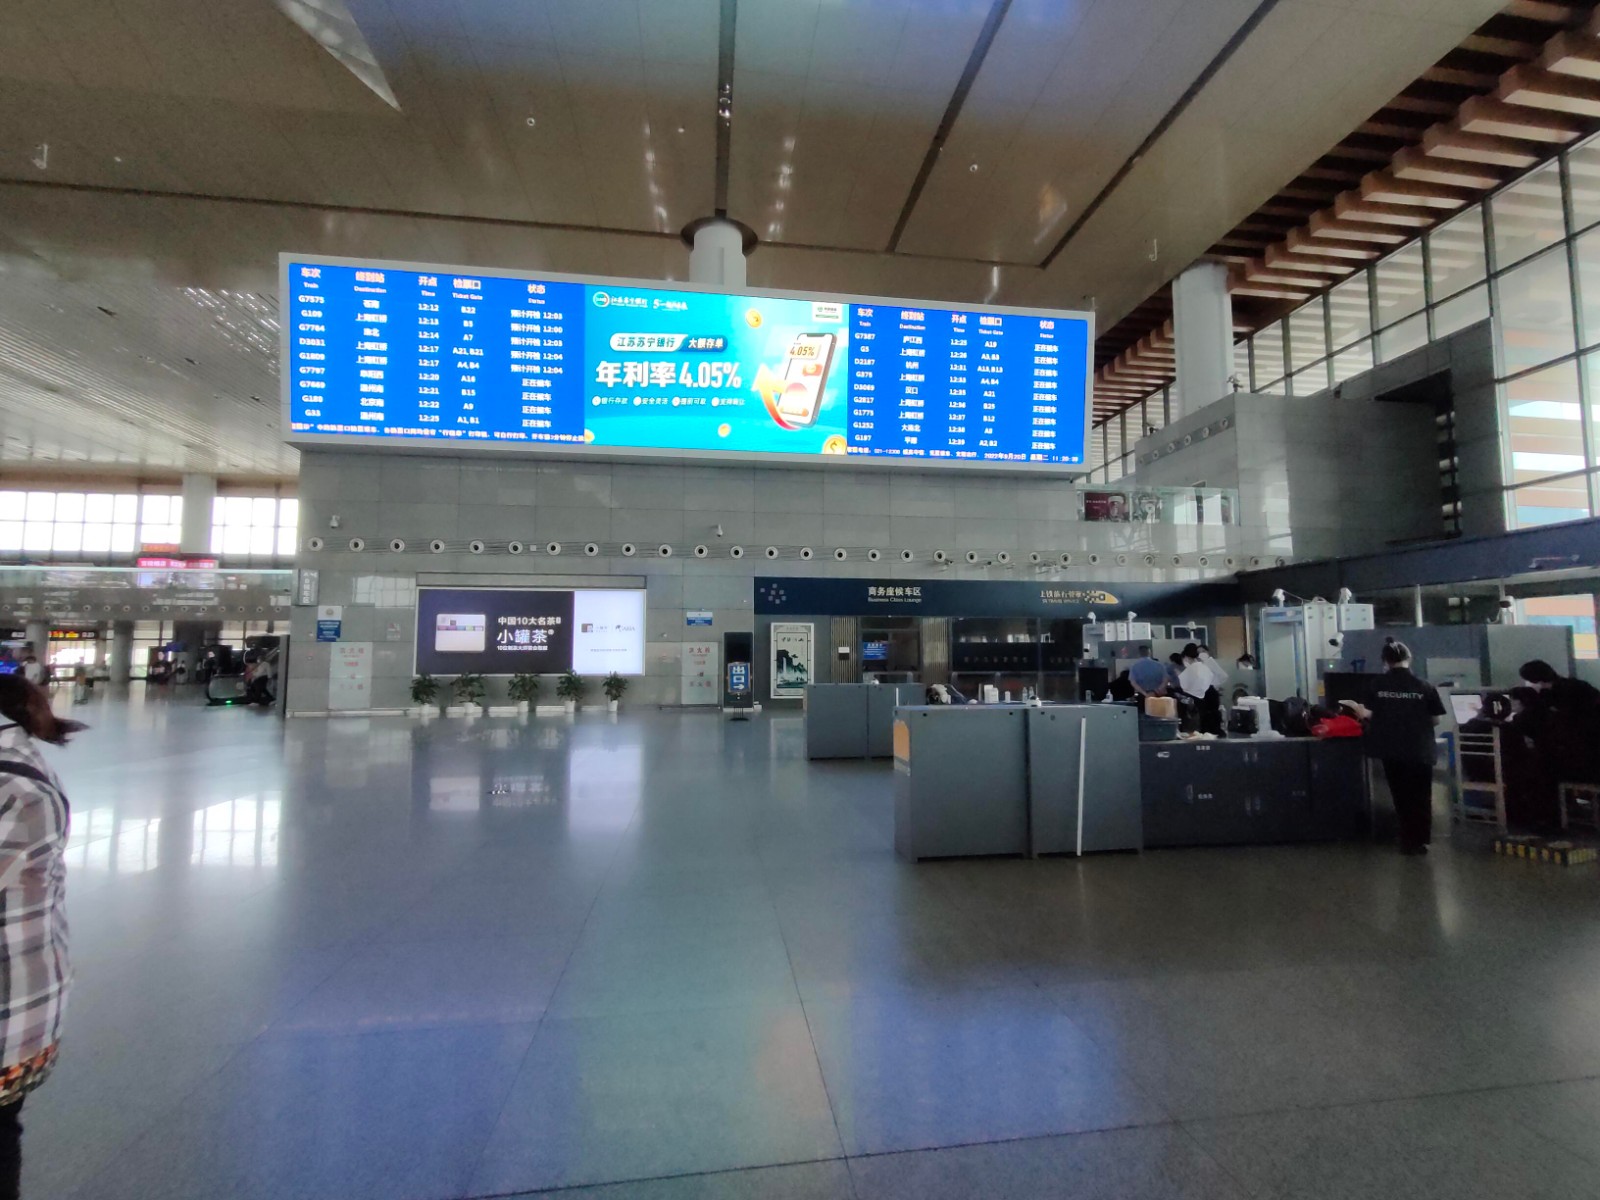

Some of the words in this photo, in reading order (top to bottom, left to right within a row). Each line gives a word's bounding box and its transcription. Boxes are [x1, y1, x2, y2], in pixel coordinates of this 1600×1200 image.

[301, 267, 320, 278] 车次
[356, 271, 384, 283] 终到站
[417, 275, 438, 287] 开点
[452, 278, 482, 290] 检票口
[527, 283, 546, 295] 状态
[857, 307, 874, 317] 车次
[900, 310, 925, 322] 终到站
[951, 313, 967, 324] 开点
[979, 316, 1003, 327] 检票口
[1039, 320, 1055, 330] 状态
[463, 333, 473, 341] A7
[617, 337, 676, 348] 江苏苏宁银行
[688, 337, 724, 349] 大额存单
[1034, 343, 1059, 353] 正在候车
[790, 346, 816, 357] 4.05%
[1034, 356, 1059, 365] 正在候车
[595, 361, 742, 389] 年利率4.05%
[1033, 368, 1058, 377] 正在候车
[521, 378, 552, 388] 正在候车
[1033, 380, 1058, 390] 正在候车
[521, 391, 552, 402] 正在候车
[905, 386, 919, 395] 汉口
[1033, 392, 1058, 402] 正在候车
[521, 405, 552, 415] 正在候车
[1032, 405, 1057, 414] 正在候车
[522, 419, 552, 428] 正在候车
[1032, 417, 1057, 426] 正在候车
[1032, 429, 1057, 438] 正在候车
[1031, 441, 1056, 450] 正在候车
[868, 586, 922, 597] 商务座候车区
[497, 628, 547, 644] 小罐茶
[732, 666, 746, 684] 出口
[1377, 690, 1424, 700] SECURITY
